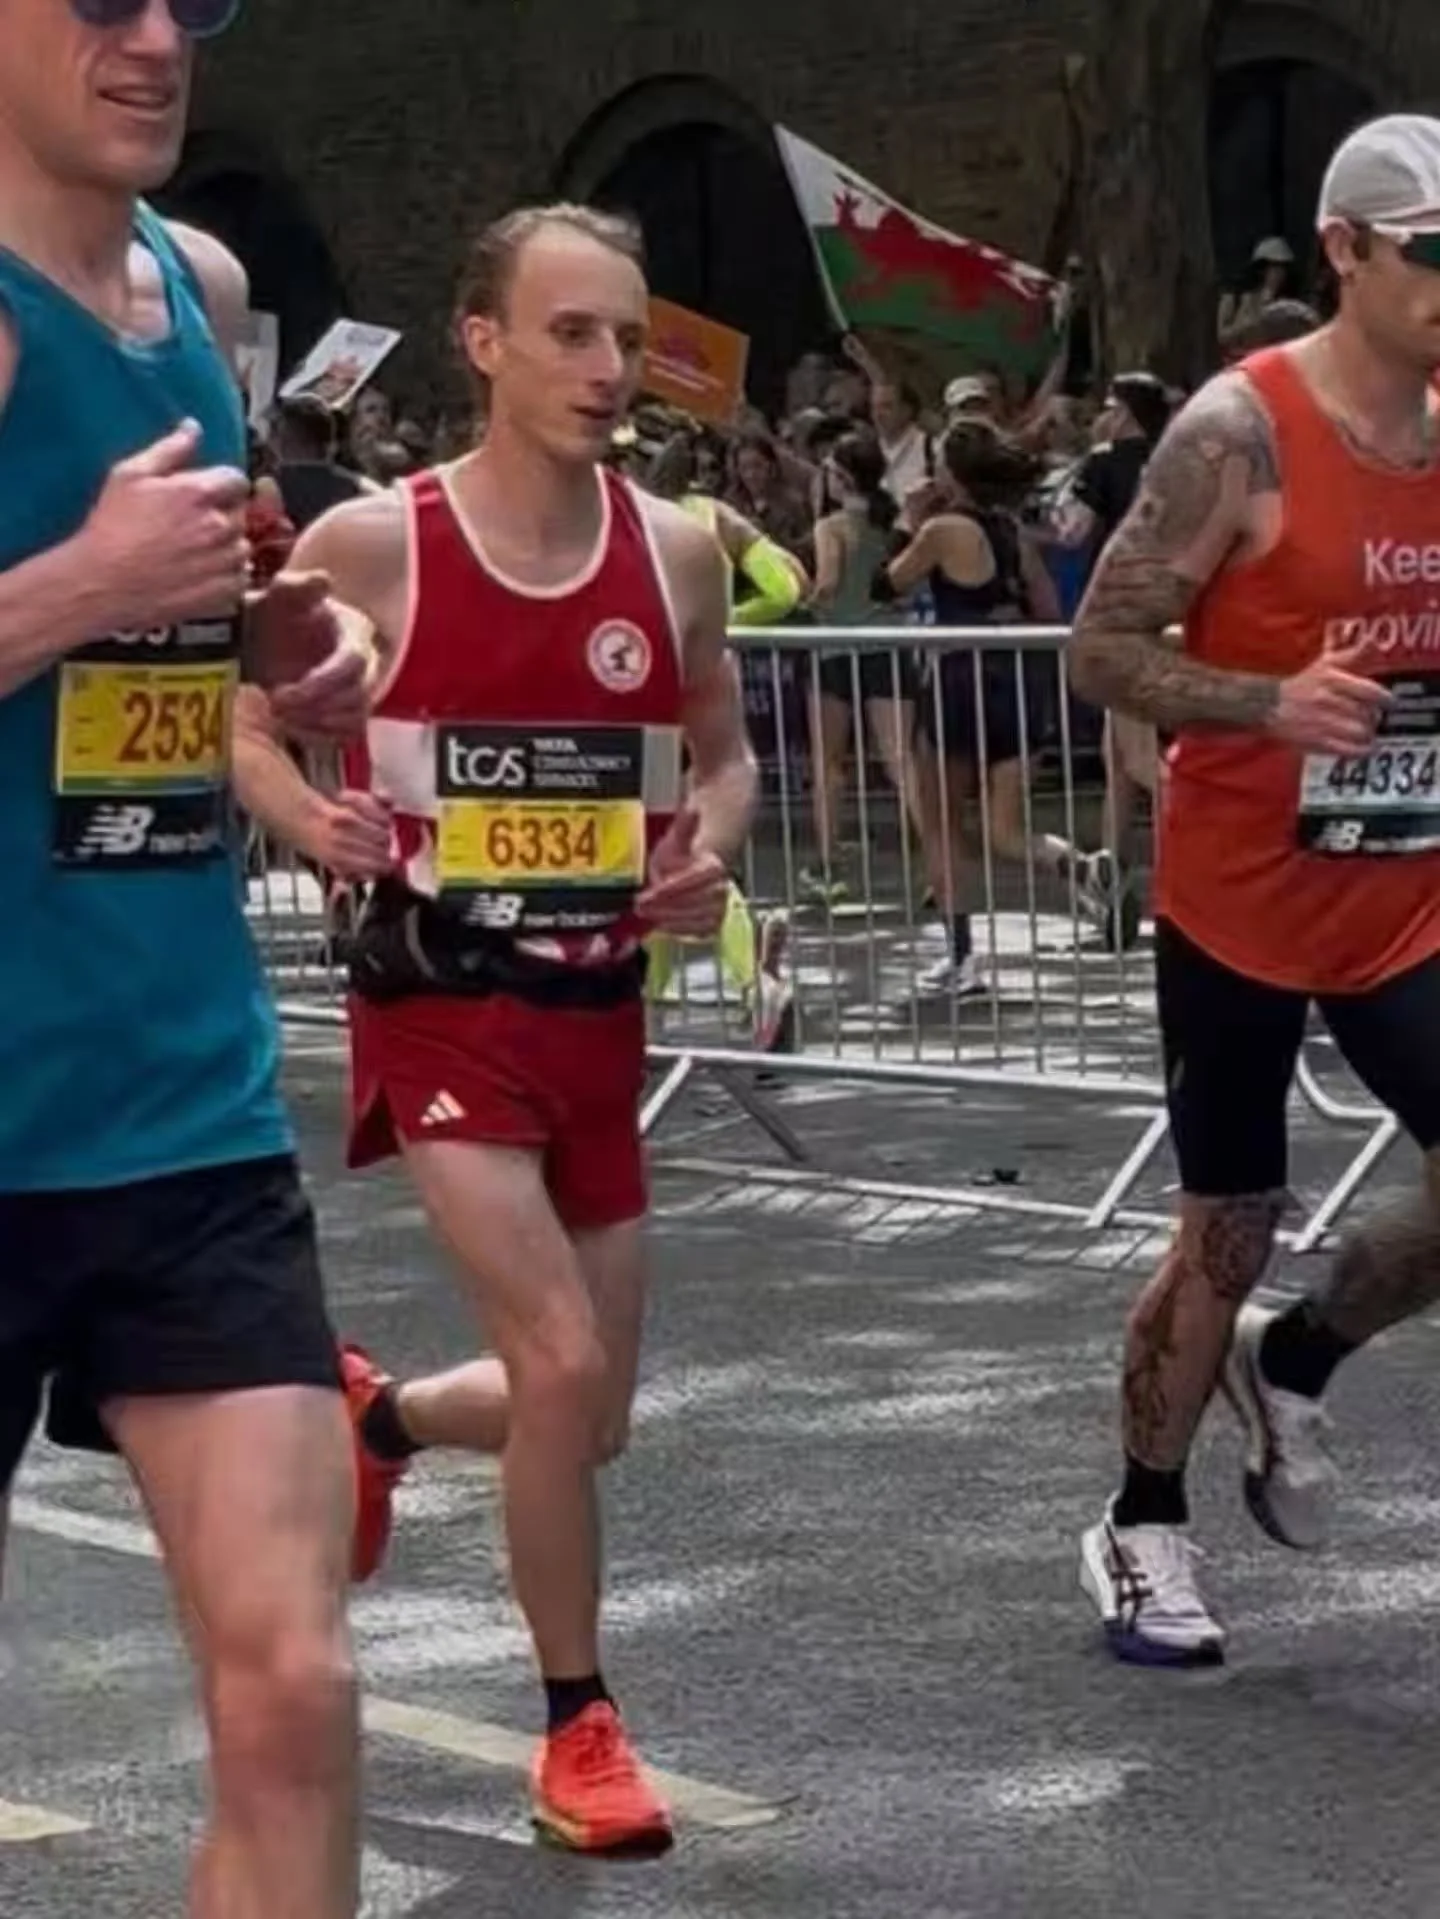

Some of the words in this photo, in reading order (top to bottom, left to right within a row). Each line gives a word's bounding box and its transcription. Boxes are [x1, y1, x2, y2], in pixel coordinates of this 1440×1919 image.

[116, 688, 224, 763] 2534
[448, 736, 527, 787] tcs
[1327, 748, 1438, 797] 44334
[486, 817, 597, 869] 6334
